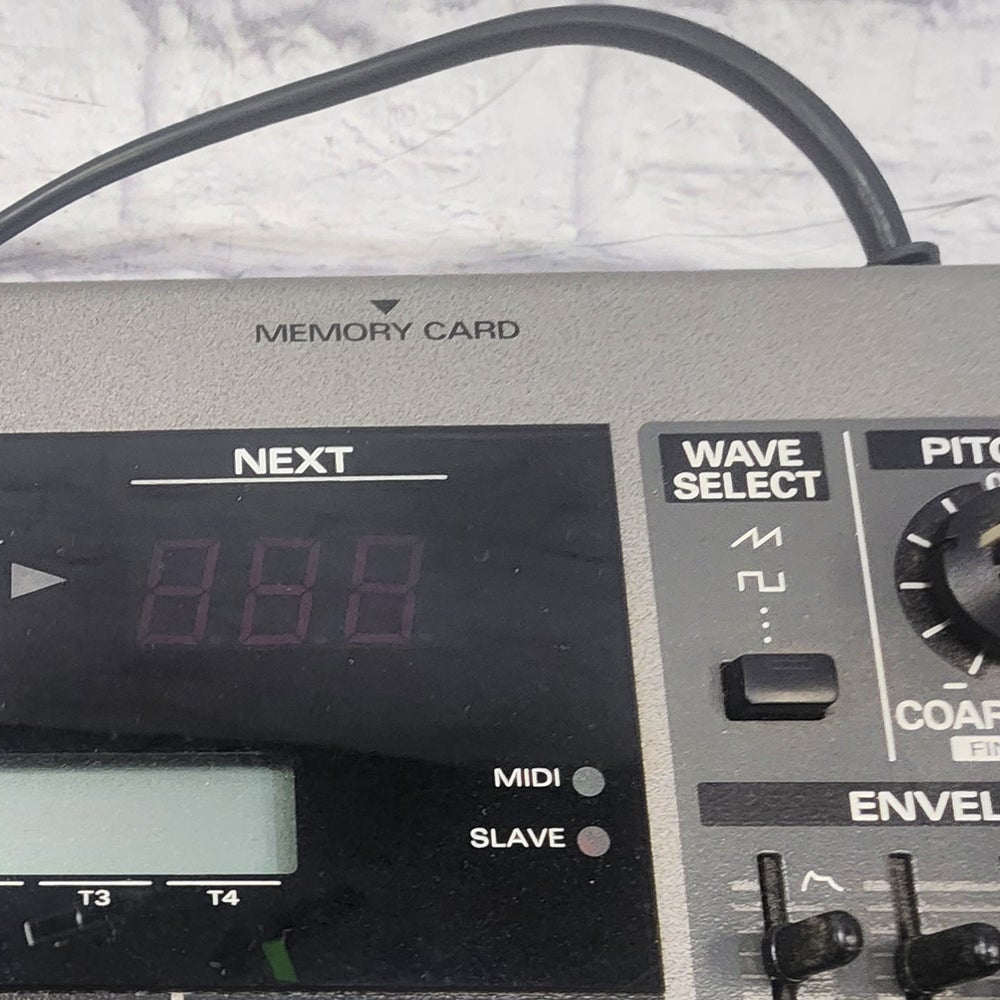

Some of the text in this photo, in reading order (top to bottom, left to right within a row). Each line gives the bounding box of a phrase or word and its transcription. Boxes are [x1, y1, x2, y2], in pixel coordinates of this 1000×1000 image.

[255, 320, 520, 343] MEMORY CARD
[233, 446, 353, 475] NEXT
[682, 439, 804, 468] WAVE
[672, 470, 822, 500] SELECT
[970, 741, 1000, 757] FI
[493, 768, 561, 788] MIDI
[848, 790, 1000, 821] ENVEL
[469, 827, 566, 849] SLAVE
[77, 890, 112, 906] T3
[206, 890, 241, 906] T4
